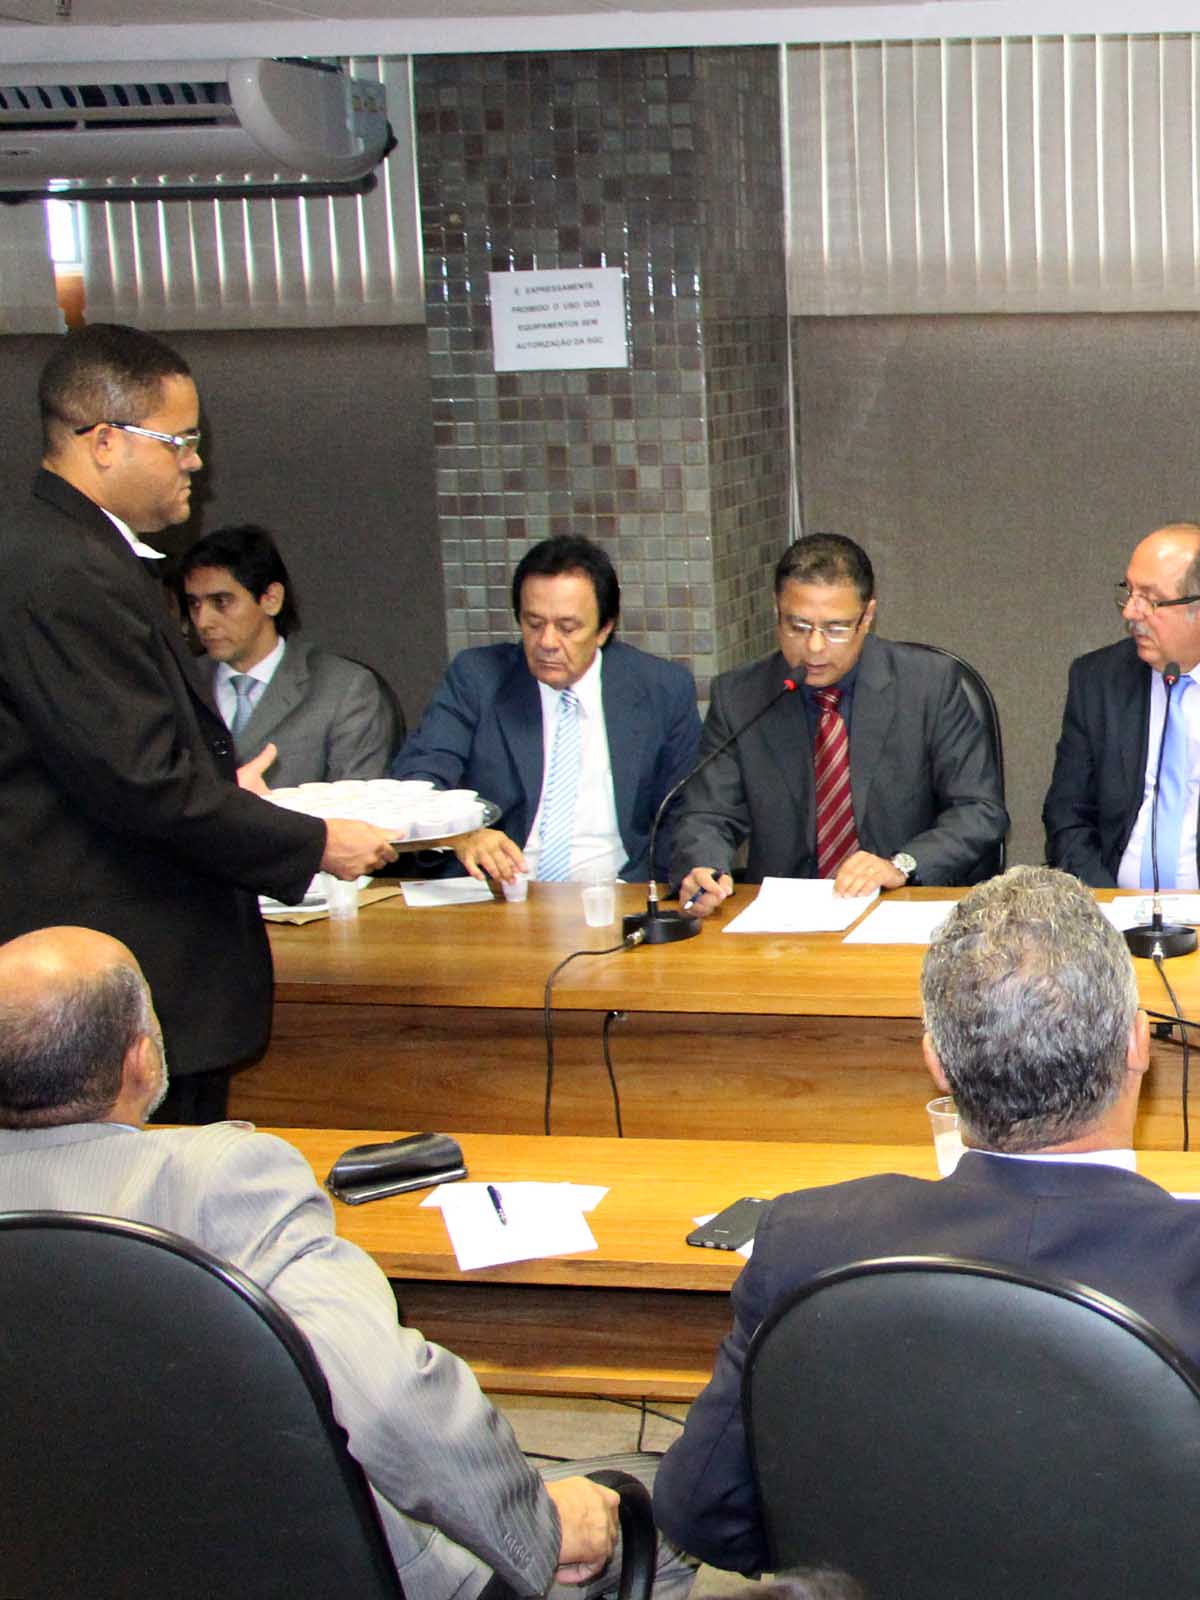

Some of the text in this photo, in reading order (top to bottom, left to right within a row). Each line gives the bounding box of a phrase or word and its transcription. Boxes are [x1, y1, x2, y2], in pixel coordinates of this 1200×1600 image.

[525, 281, 594, 295] EXPRESSAMENTE
[511, 304, 550, 313] PROIBIDO
[552, 303, 560, 311] O
[517, 319, 579, 332] EQUIPAMENTOS
